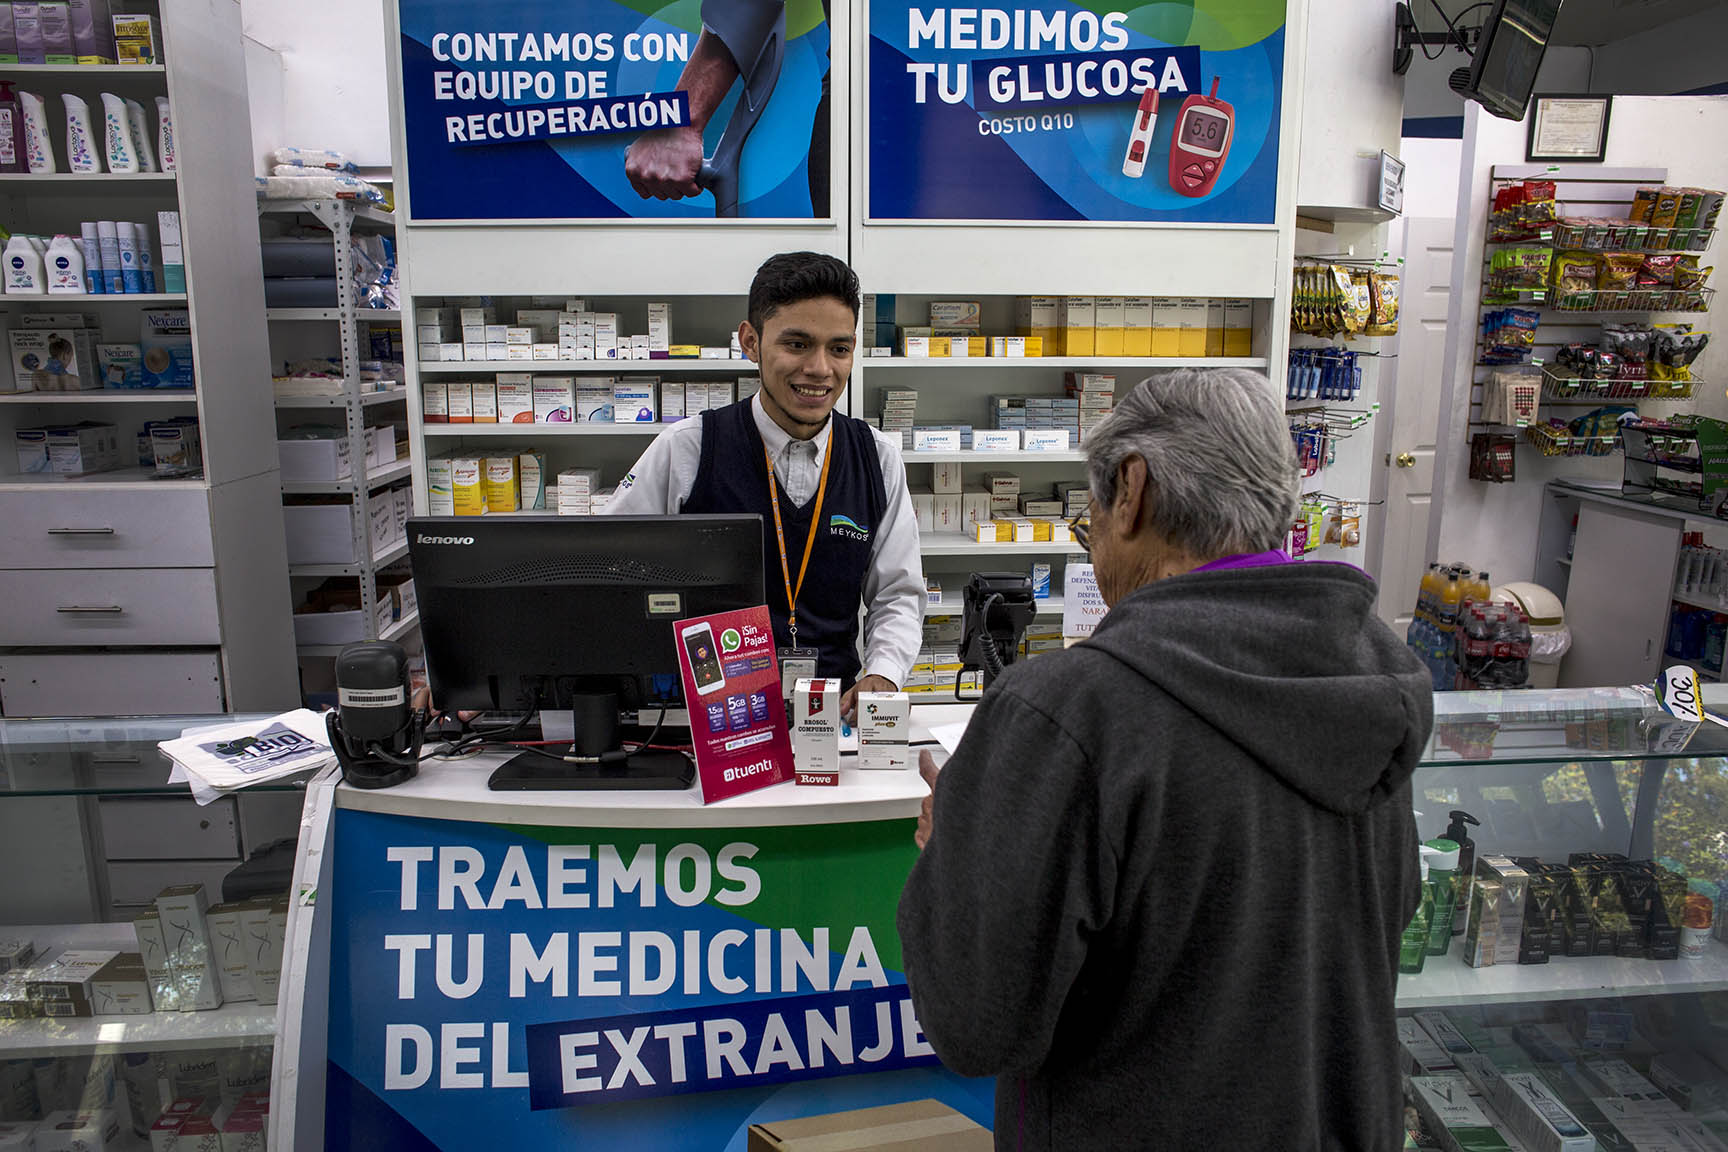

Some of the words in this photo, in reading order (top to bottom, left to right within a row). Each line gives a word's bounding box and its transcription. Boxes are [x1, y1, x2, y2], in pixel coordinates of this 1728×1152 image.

[908, 7, 1130, 51] MEDIMOS
[431, 32, 615, 63] CONTAMOS
[623, 33, 688, 62] CON
[434, 71, 556, 102] EQUIPO
[565, 71, 607, 99] DE
[906, 63, 968, 104] TU
[988, 55, 1188, 104] GLUCOSA
[445, 93, 682, 143] RECUPERACIÓN
[978, 115, 1037, 136] COSTO
[1041, 113, 1074, 132] Q10
[1191, 116, 1218, 140] 5.6
[148, 315, 186, 329] Nexcare
[417, 534, 474, 545] lenovo
[830, 527, 869, 541] MEYKOS
[1081, 607, 1108, 616] NARA
[742, 625, 758, 637] ¡Sin
[744, 633, 768, 647] Pajas!
[728, 696, 746, 710] 5GB
[750, 694, 766, 706] 3GB
[1671, 676, 1698, 716] 30%
[735, 759, 773, 779] tuenti
[800, 774, 832, 784] Rowe
[387, 842, 762, 911] TRAEMOS
[384, 933, 485, 999] TU
[509, 926, 889, 997] MEDICINA
[384, 1022, 529, 1090] DEL
